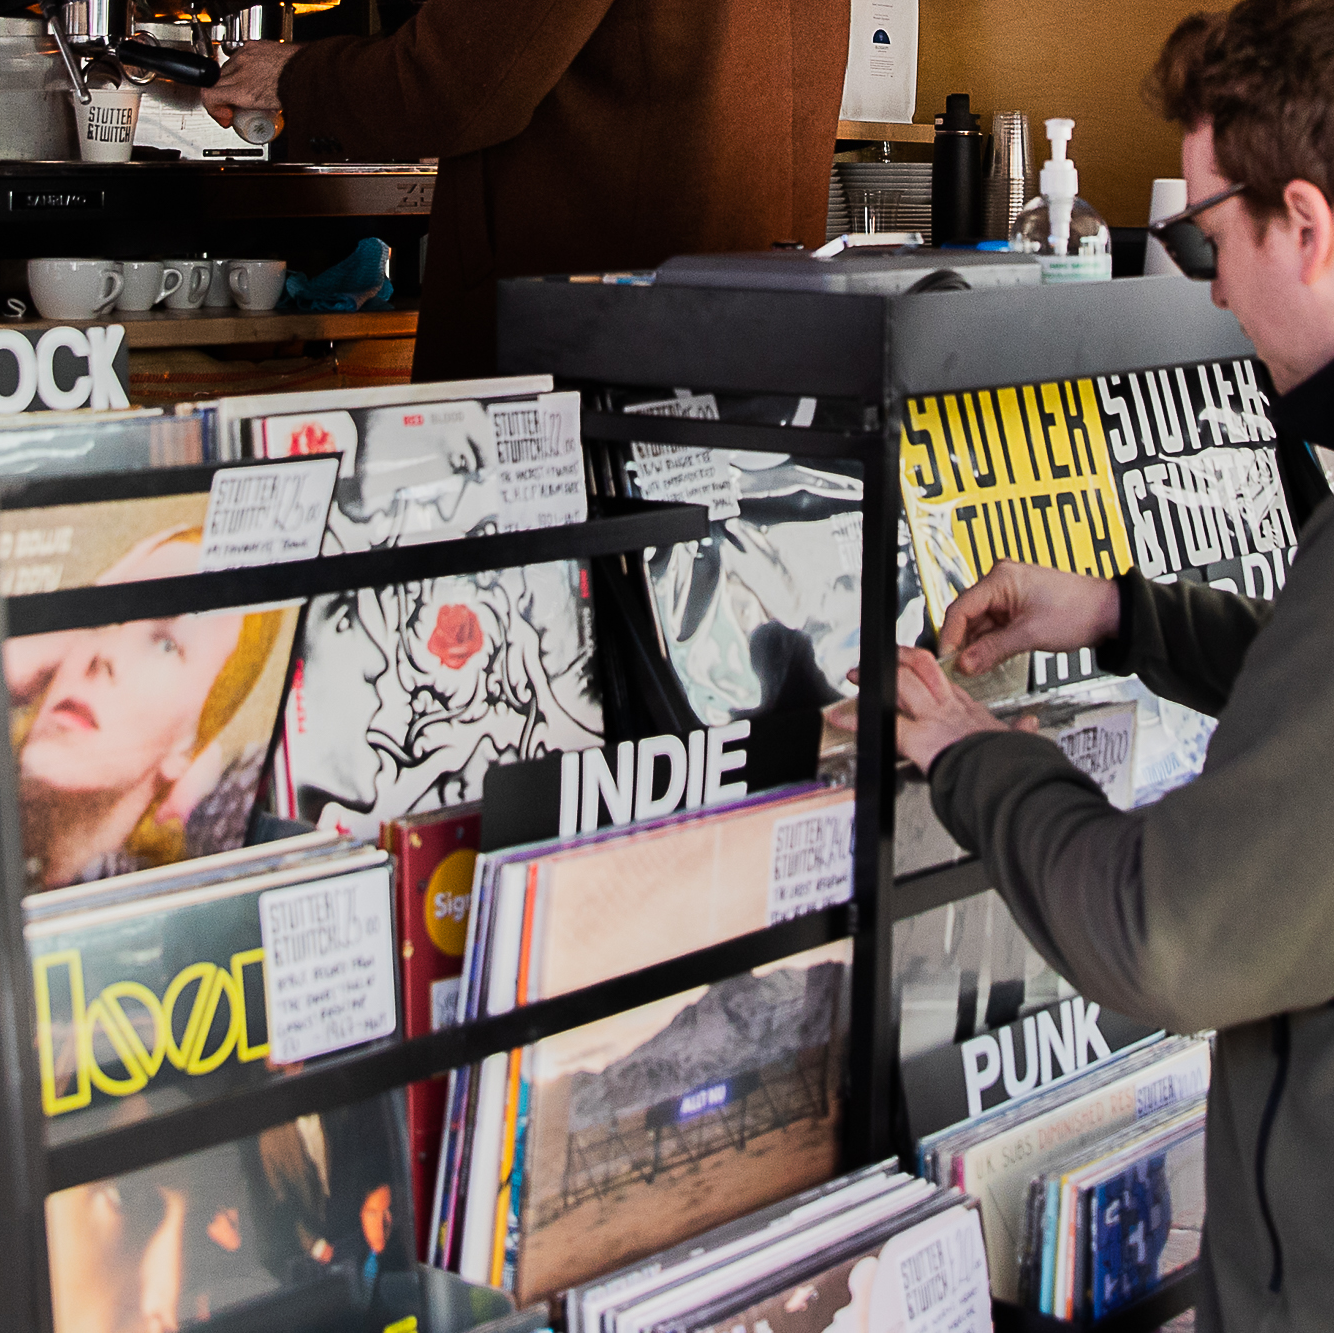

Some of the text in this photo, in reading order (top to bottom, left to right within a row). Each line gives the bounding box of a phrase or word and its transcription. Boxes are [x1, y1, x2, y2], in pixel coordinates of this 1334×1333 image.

[86, 123, 132, 143] &TWITCH
[88, 105, 133, 126] STUTTER
[493, 410, 540, 438] STUTTER
[903, 379, 1097, 499] STUTTER
[1097, 359, 1277, 464] STUTTER
[956, 488, 1120, 580] TWITCH
[1122, 446, 1298, 579] &TWITCH
[559, 719, 753, 837] INDIE
[962, 995, 1113, 1119] PUNK
